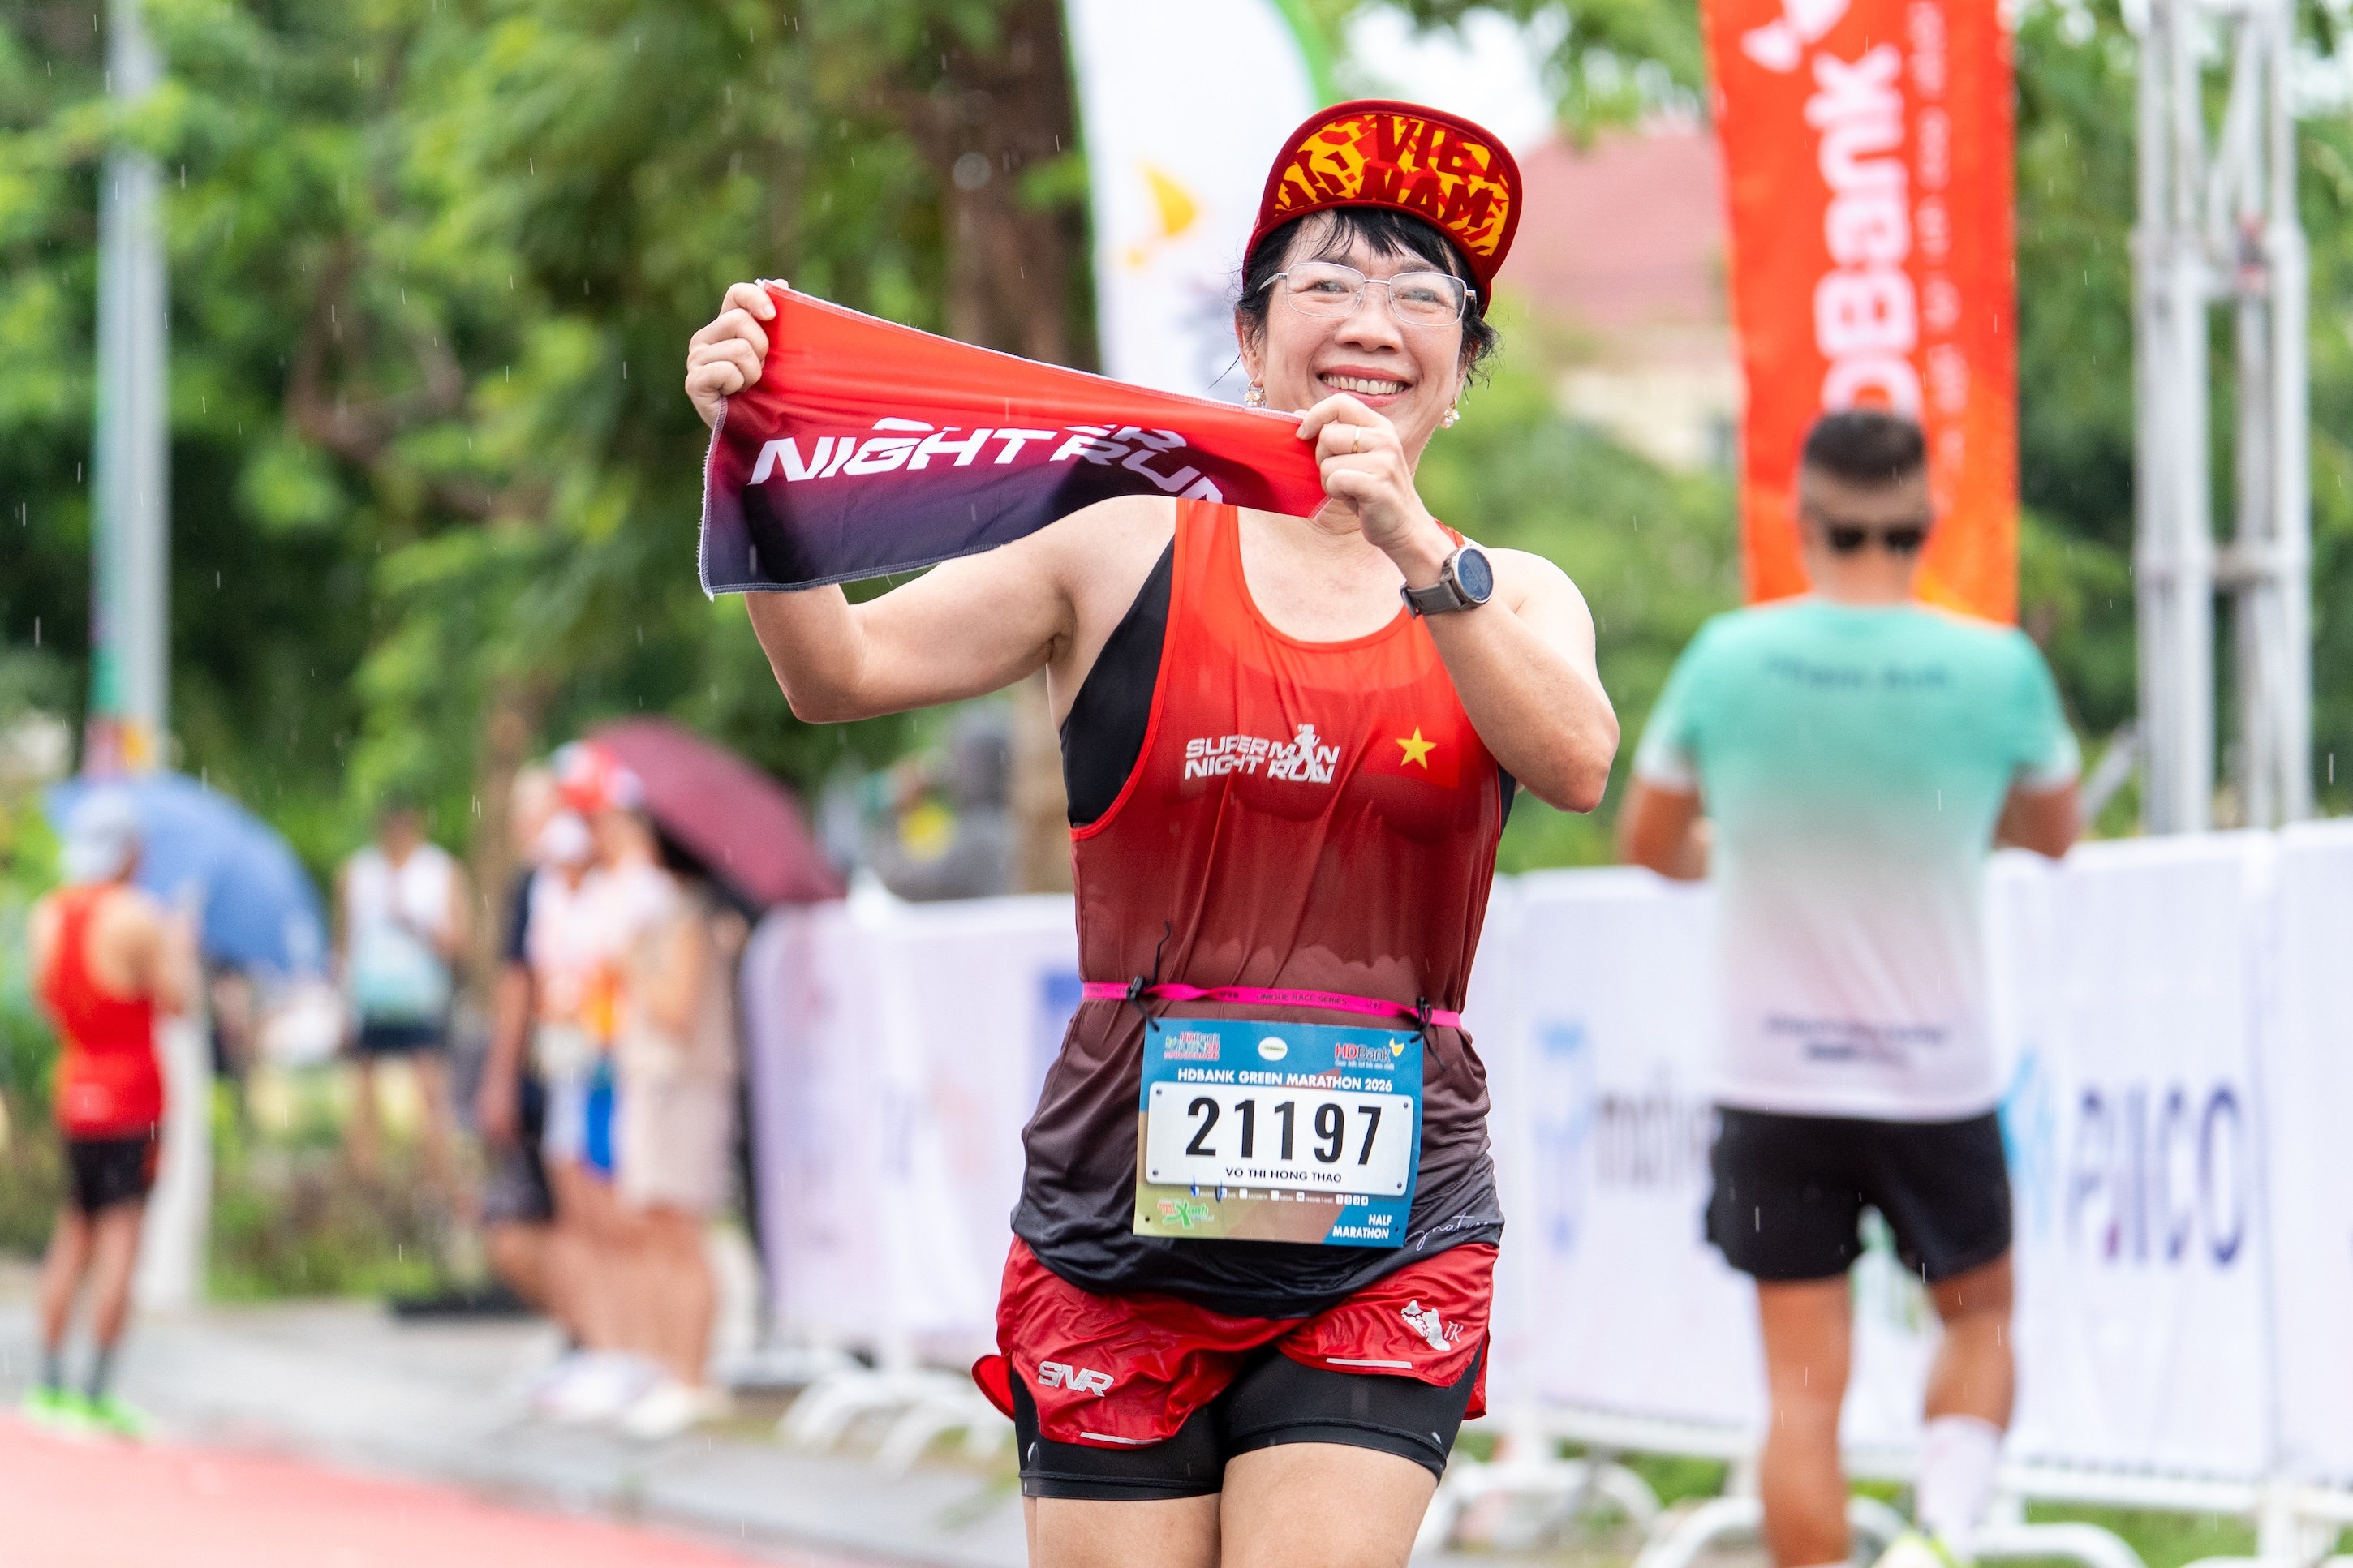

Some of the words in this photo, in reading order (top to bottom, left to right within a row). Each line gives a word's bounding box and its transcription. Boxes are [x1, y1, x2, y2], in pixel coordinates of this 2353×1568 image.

[1357, 165, 1494, 229] NAM
[1804, 43, 1921, 415] DBank
[746, 427, 1058, 486] NIGHT
[1185, 754, 1265, 780] NIGHT
[1267, 759, 1335, 784] RUN
[1292, 994, 1314, 1002] RACE
[1335, 1042, 1391, 1063] HDBank
[1177, 1068, 1235, 1084] HDBANK
[1238, 1071, 1284, 1086] GREEN
[1286, 1072, 1361, 1090] MARATHON
[1364, 1078, 1393, 1093] 2026
[1185, 1097, 1383, 1166] 21197
[1225, 1167, 1244, 1178] VO
[1248, 1168, 1266, 1179] THI
[1271, 1170, 1308, 1181] HONG
[1311, 1172, 1343, 1184] THAO
[1332, 1225, 1390, 1239] MARATHON
[1368, 1214, 1393, 1226] HALF
[1038, 1360, 1115, 1397] SNR
